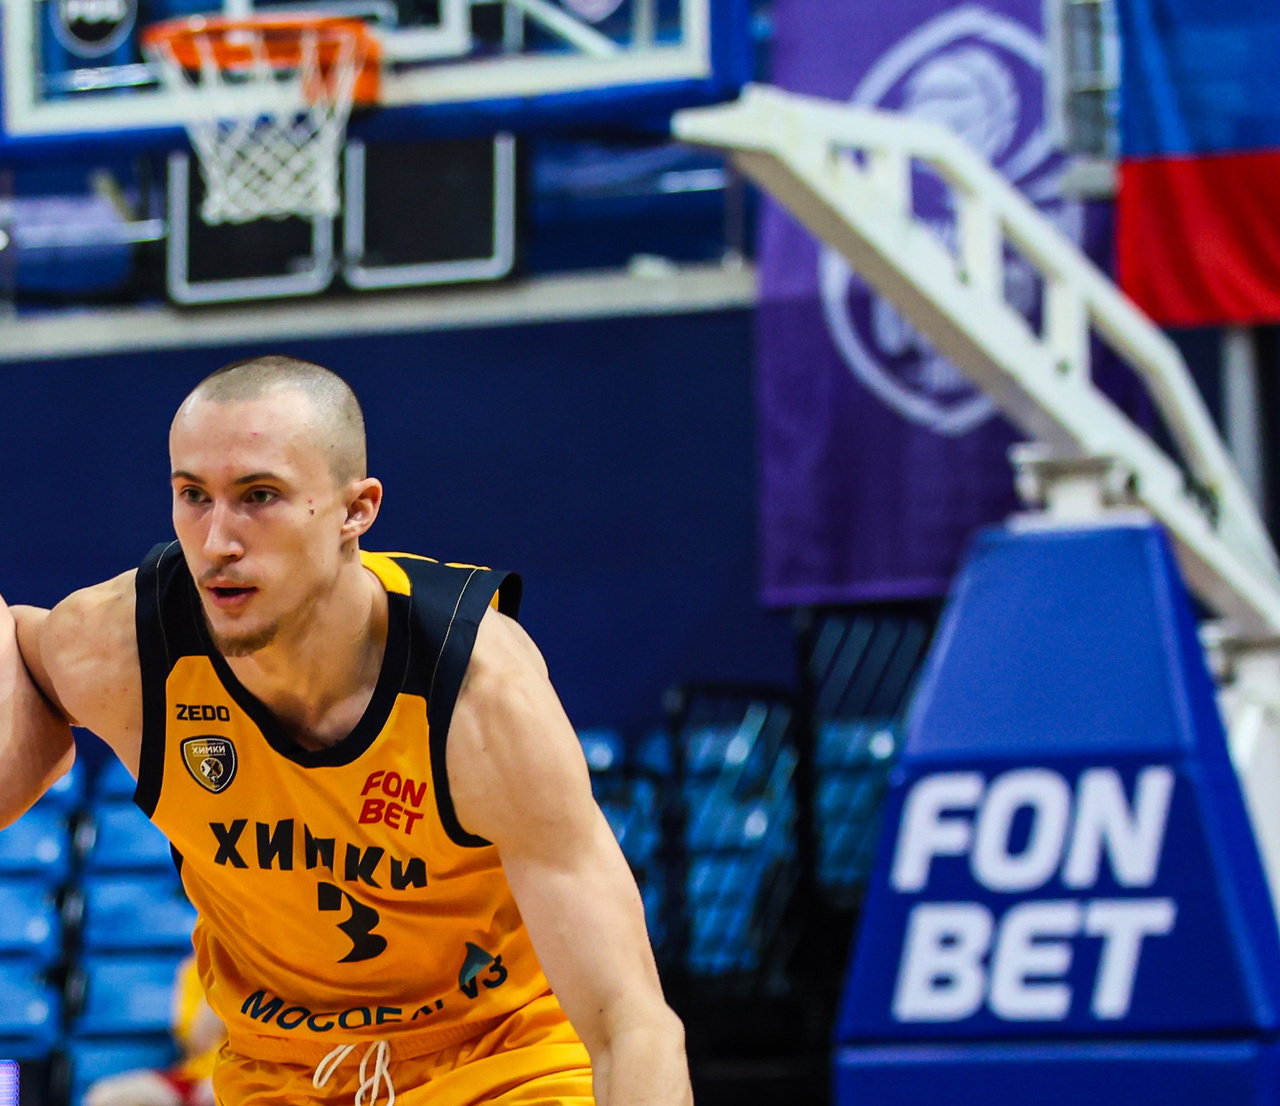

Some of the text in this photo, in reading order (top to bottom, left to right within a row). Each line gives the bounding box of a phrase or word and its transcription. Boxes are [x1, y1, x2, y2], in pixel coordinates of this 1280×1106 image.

[176, 703, 230, 722] ZEDO
[191, 745, 226, 755] ХИМКИ
[360, 769, 428, 808] FON
[358, 798, 424, 835] BET
[888, 766, 1176, 893] FON
[317, 881, 388, 963] 3
[890, 898, 1178, 1023] BET
